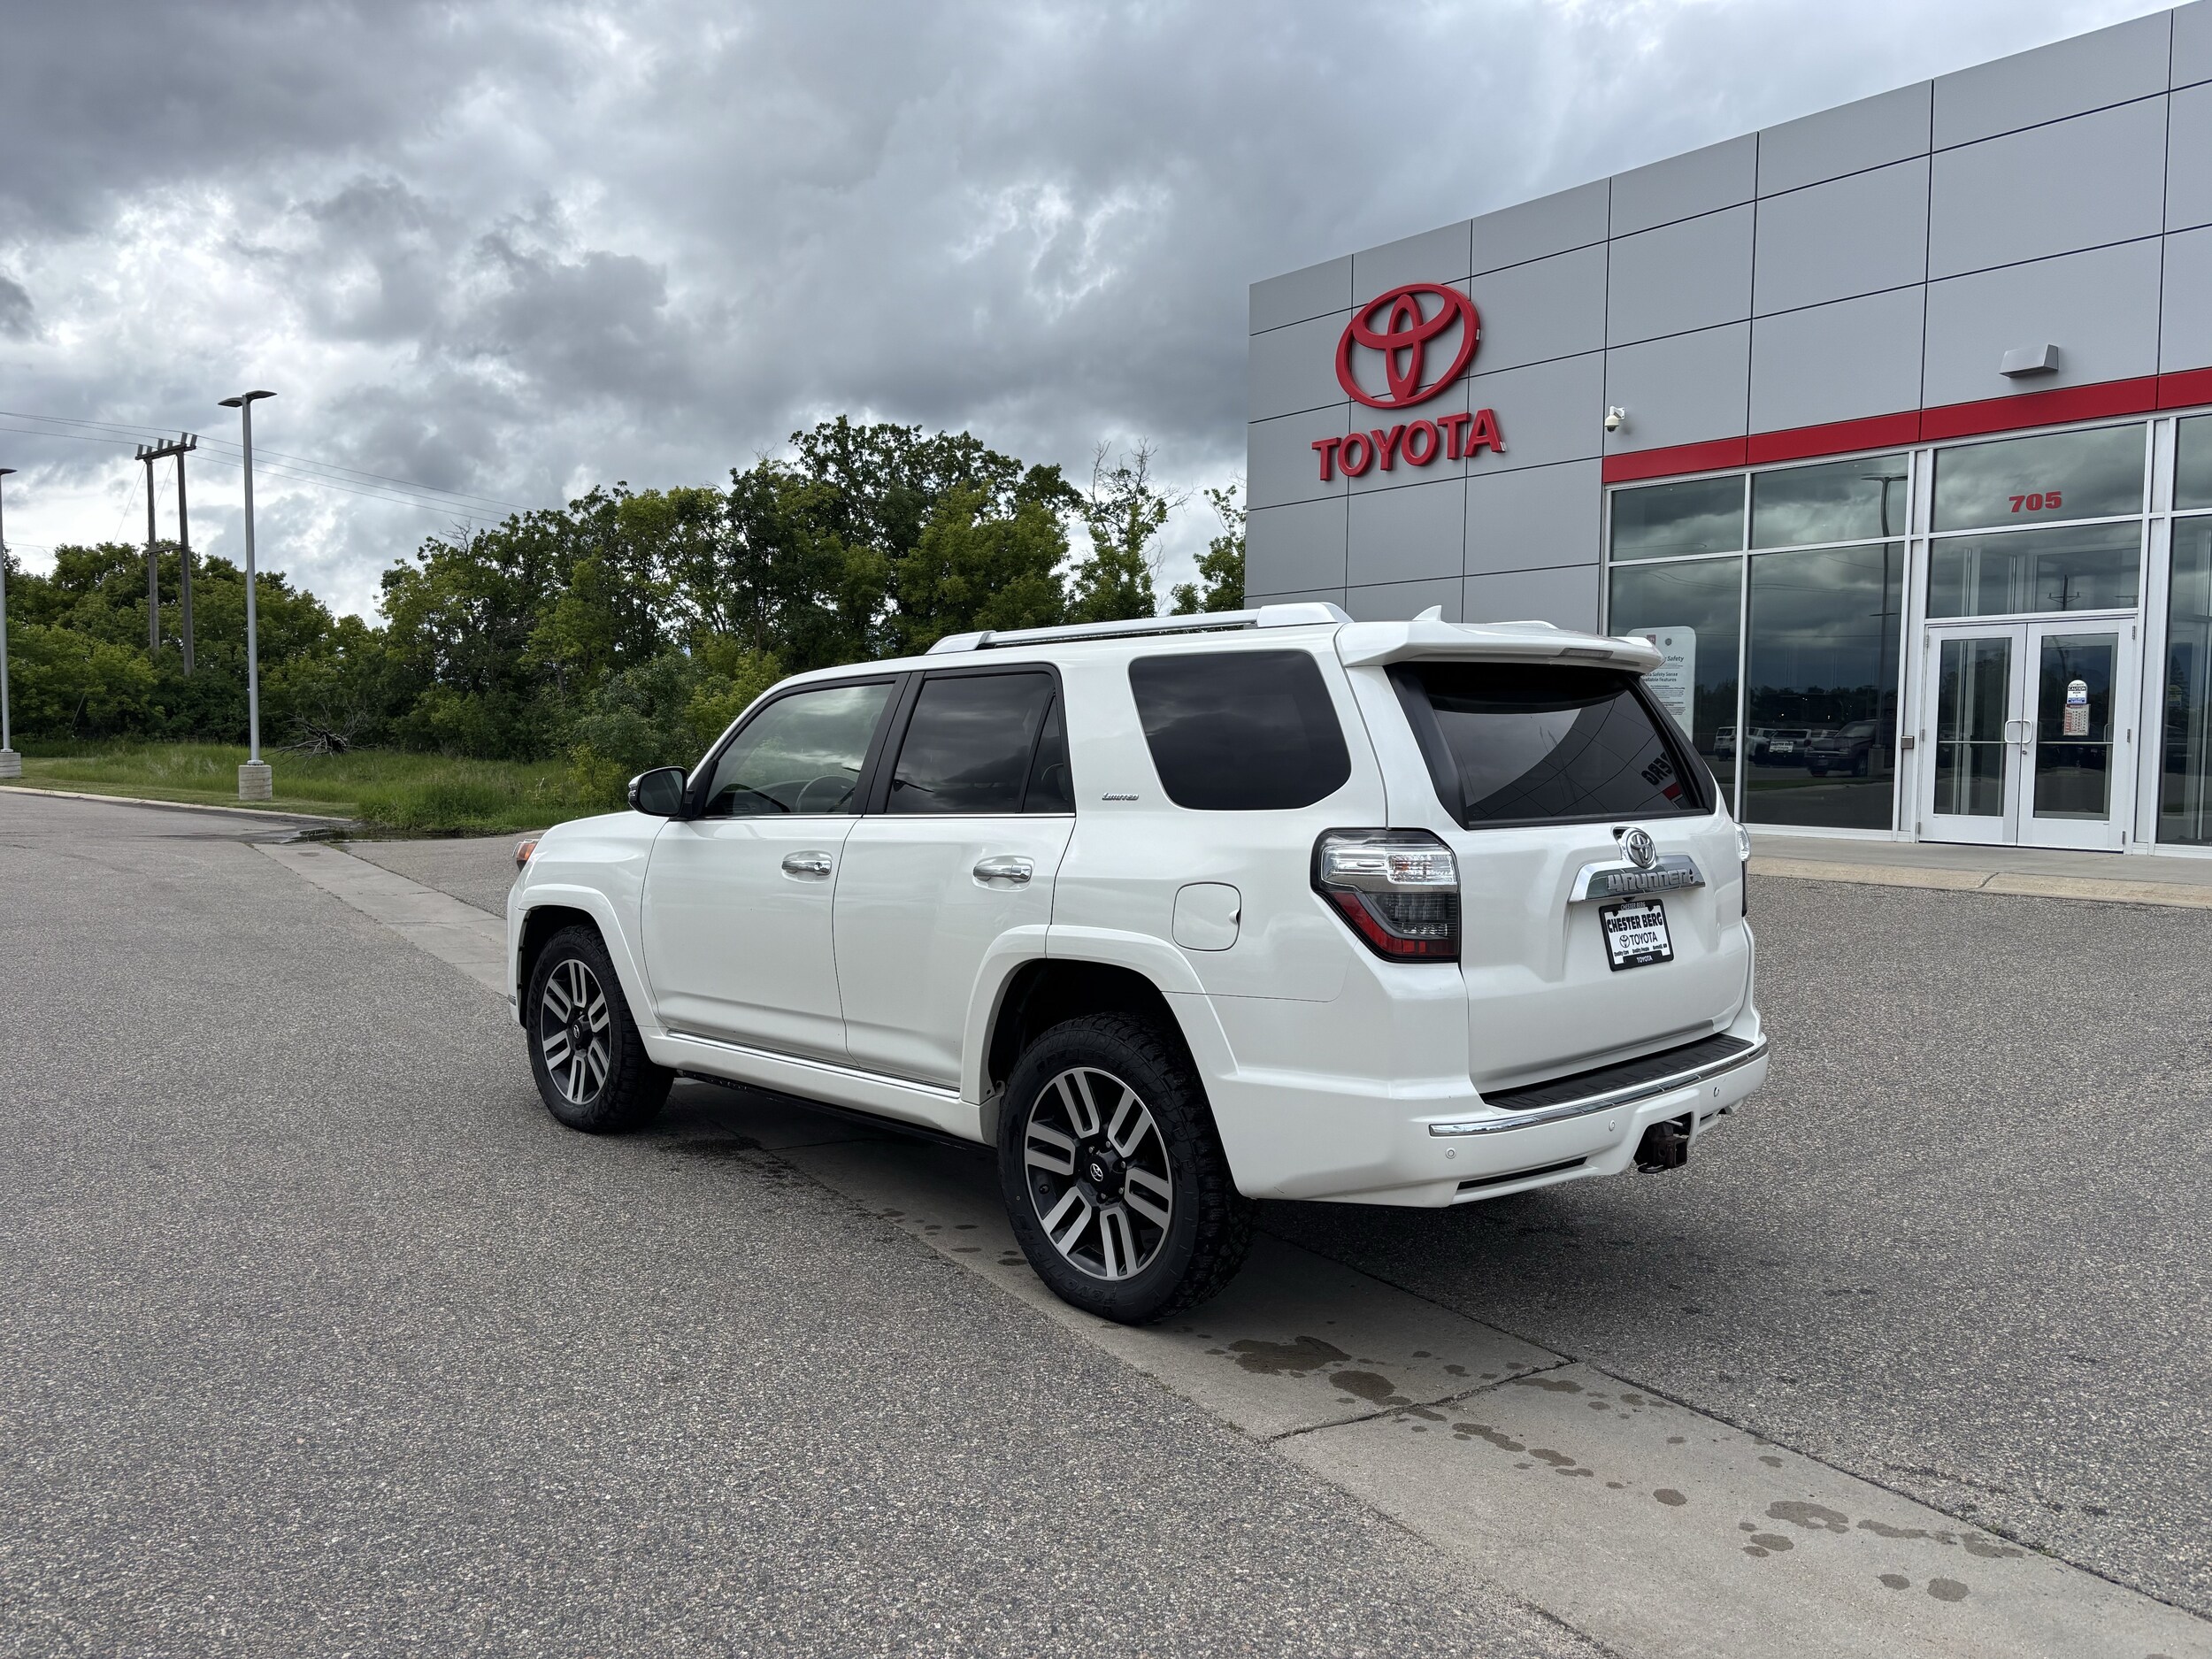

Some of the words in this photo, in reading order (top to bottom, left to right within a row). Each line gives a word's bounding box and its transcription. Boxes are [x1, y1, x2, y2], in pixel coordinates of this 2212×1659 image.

[1311, 408, 1505, 481] TOYOTA
[2008, 490, 2062, 513] 705
[1607, 916, 1641, 933] CHESTER
[1641, 912, 1663, 928] BERG
[1630, 932, 1657, 945] TOYOTA
